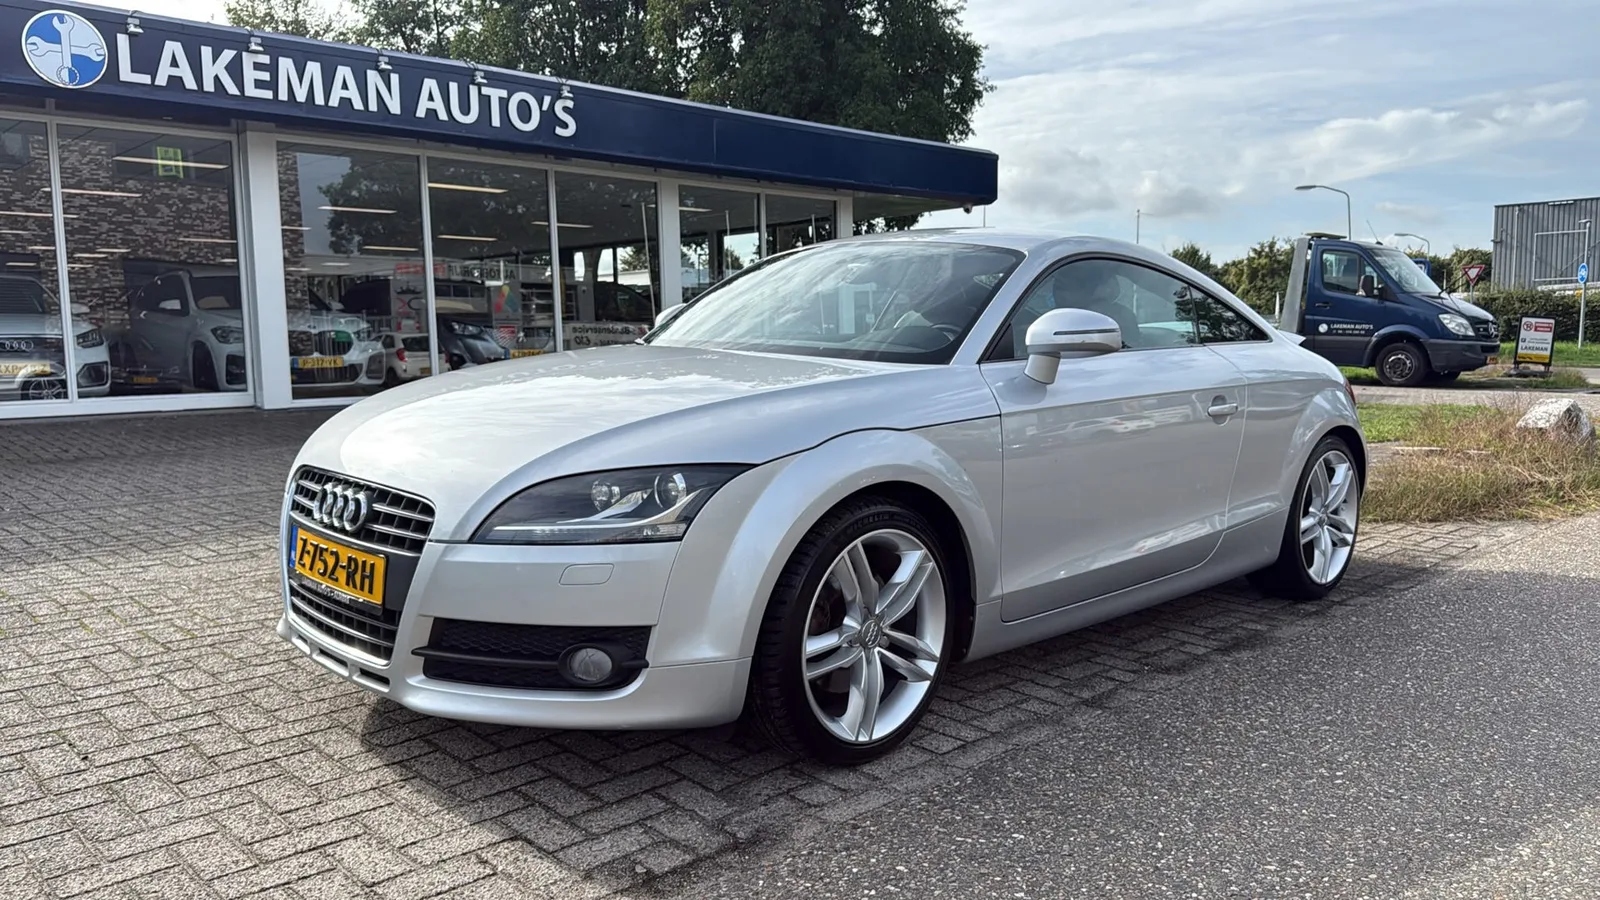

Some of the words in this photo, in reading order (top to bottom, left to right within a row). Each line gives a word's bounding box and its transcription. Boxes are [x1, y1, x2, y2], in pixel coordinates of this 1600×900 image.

[116, 33, 401, 115] LAKEMAN
[415, 77, 577, 137] AUTO'S
[297, 536, 375, 595] Z-752-RH
